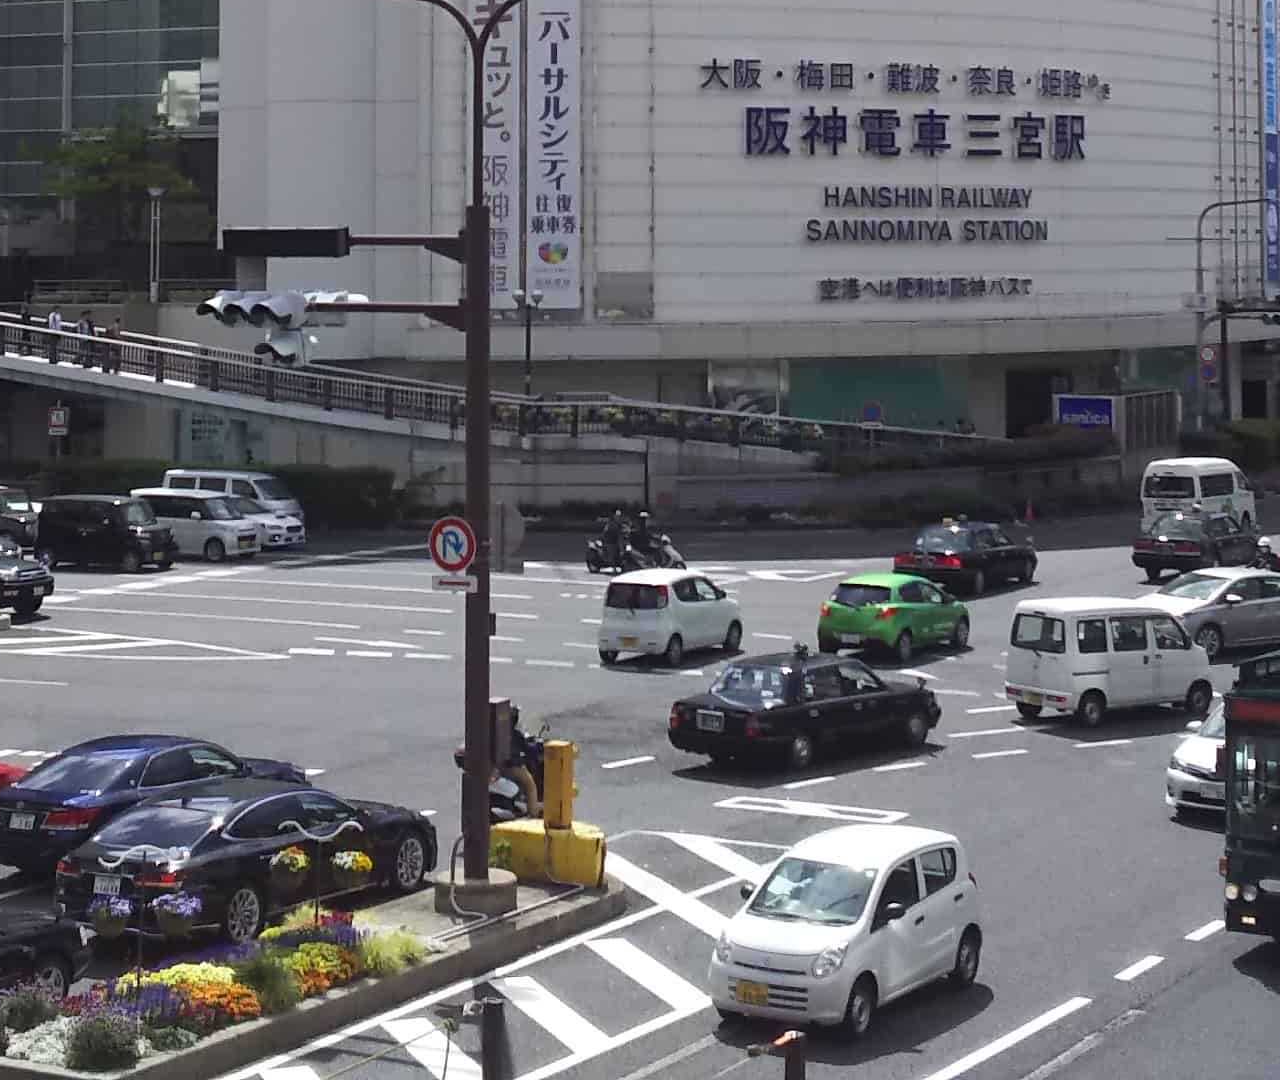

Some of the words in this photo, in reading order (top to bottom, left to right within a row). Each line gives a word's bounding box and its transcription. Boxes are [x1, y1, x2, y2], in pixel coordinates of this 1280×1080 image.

[745, 106, 1086, 161] 阪神電車三宮駅
[824, 186, 933, 209] HANSHIN
[941, 187, 1033, 209] RAILWAY
[806, 220, 953, 242] SANNOMIYA
[962, 220, 1049, 242] STATION
